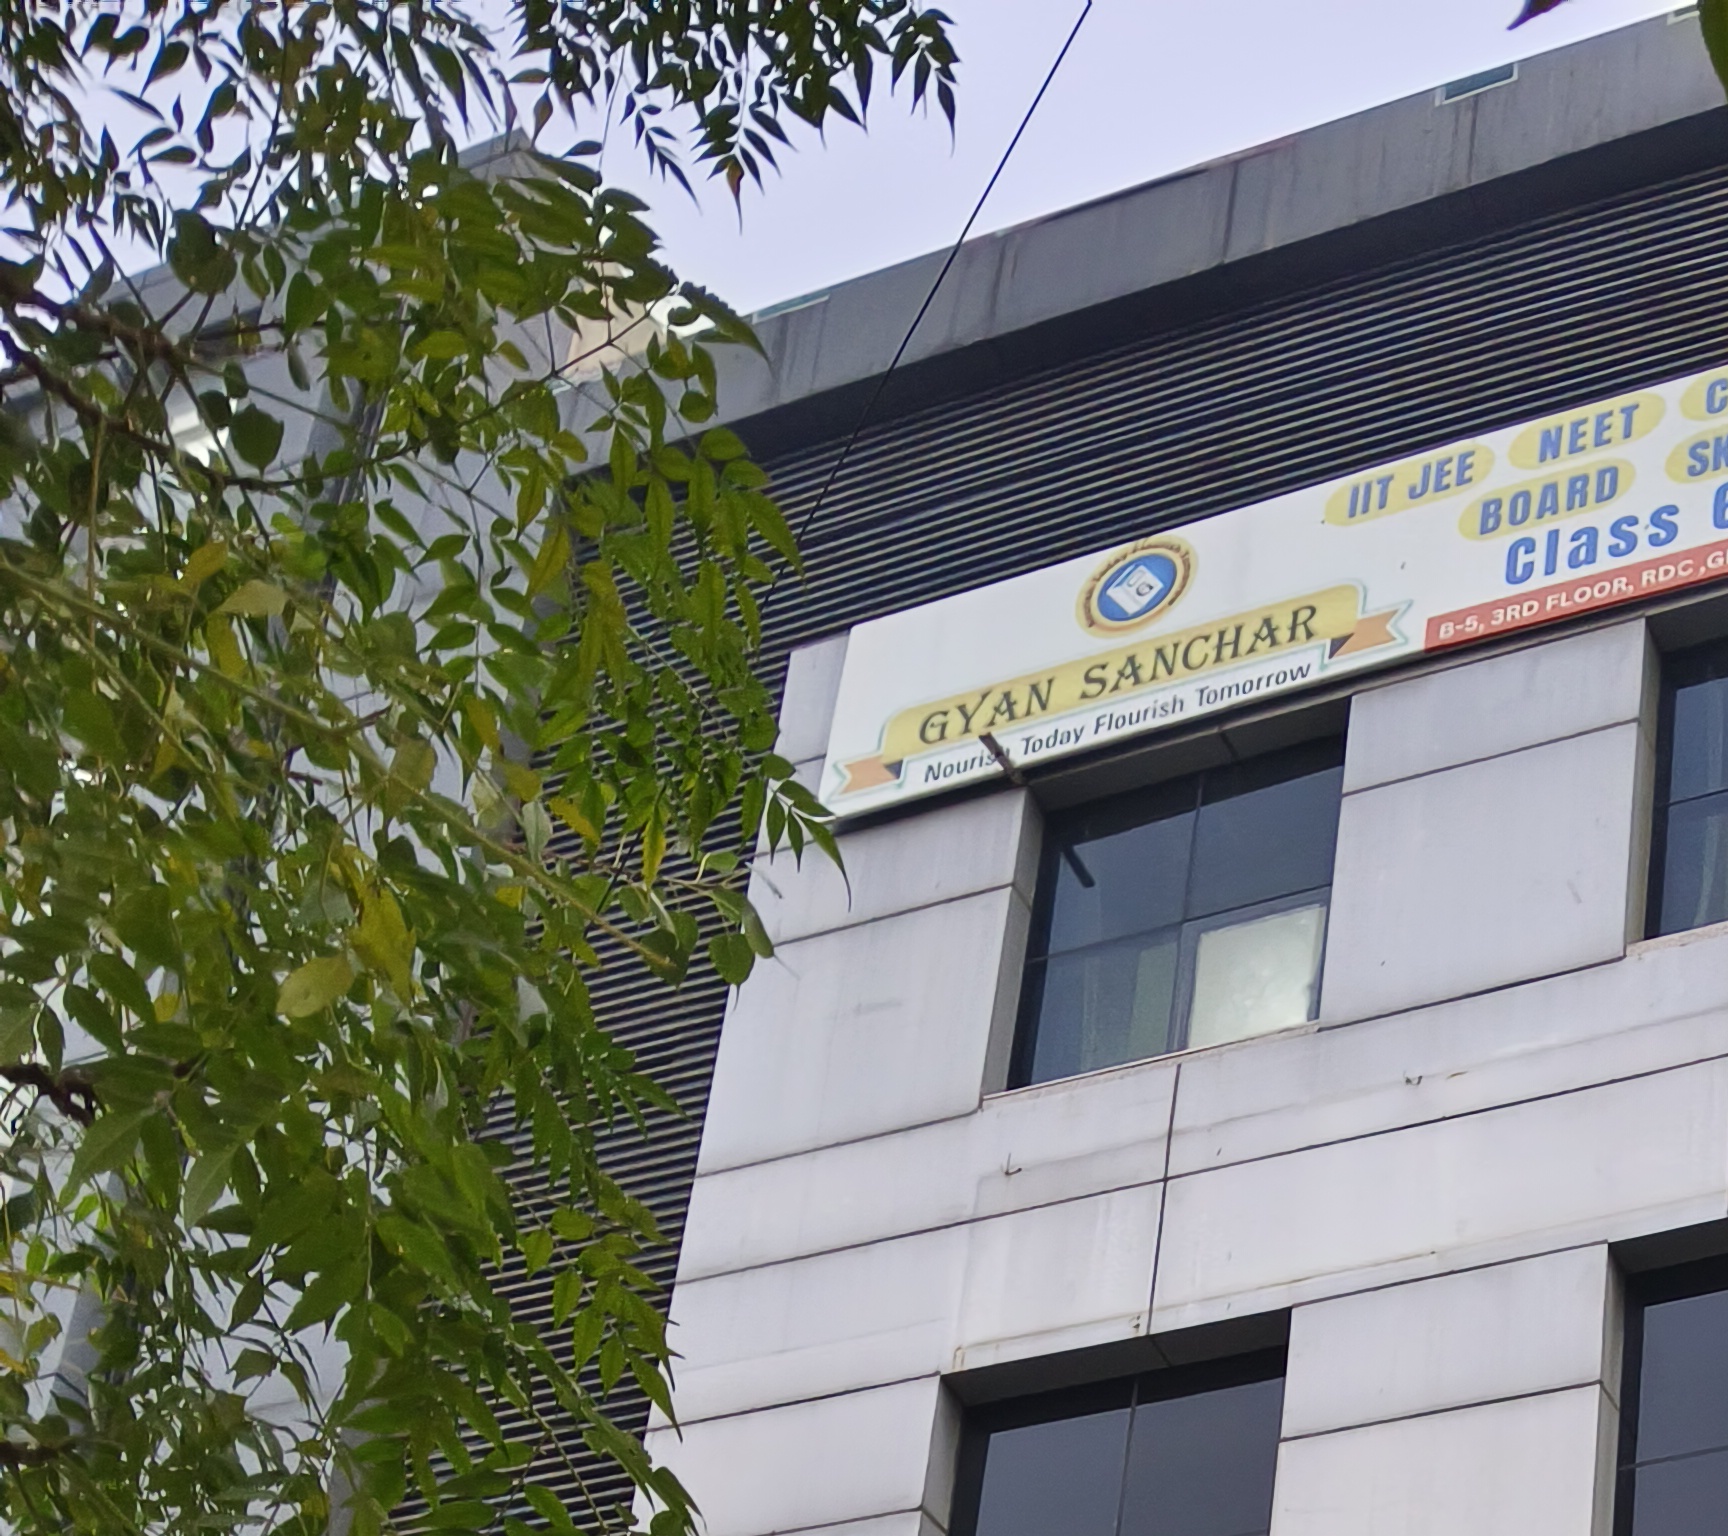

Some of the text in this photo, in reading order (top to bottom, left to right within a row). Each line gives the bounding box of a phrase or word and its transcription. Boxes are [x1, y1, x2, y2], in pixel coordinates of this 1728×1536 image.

[1347, 472, 1395, 519] IIT
[1408, 450, 1476, 500] JEE
[1538, 403, 1640, 463] NEET
[1479, 465, 1619, 535] BOARD
[1504, 503, 1680, 586] Class
[1438, 614, 1485, 641] B-5,
[1490, 600, 1540, 626] 3RD
[1545, 577, 1635, 613] FLOOR,
[1640, 559, 1694, 588] RDC
[917, 604, 1318, 745] GYAN SANCHAR
[1021, 725, 1086, 756] Today
[1093, 695, 1186, 735] Flourish
[1196, 663, 1313, 706] Tomorrow
